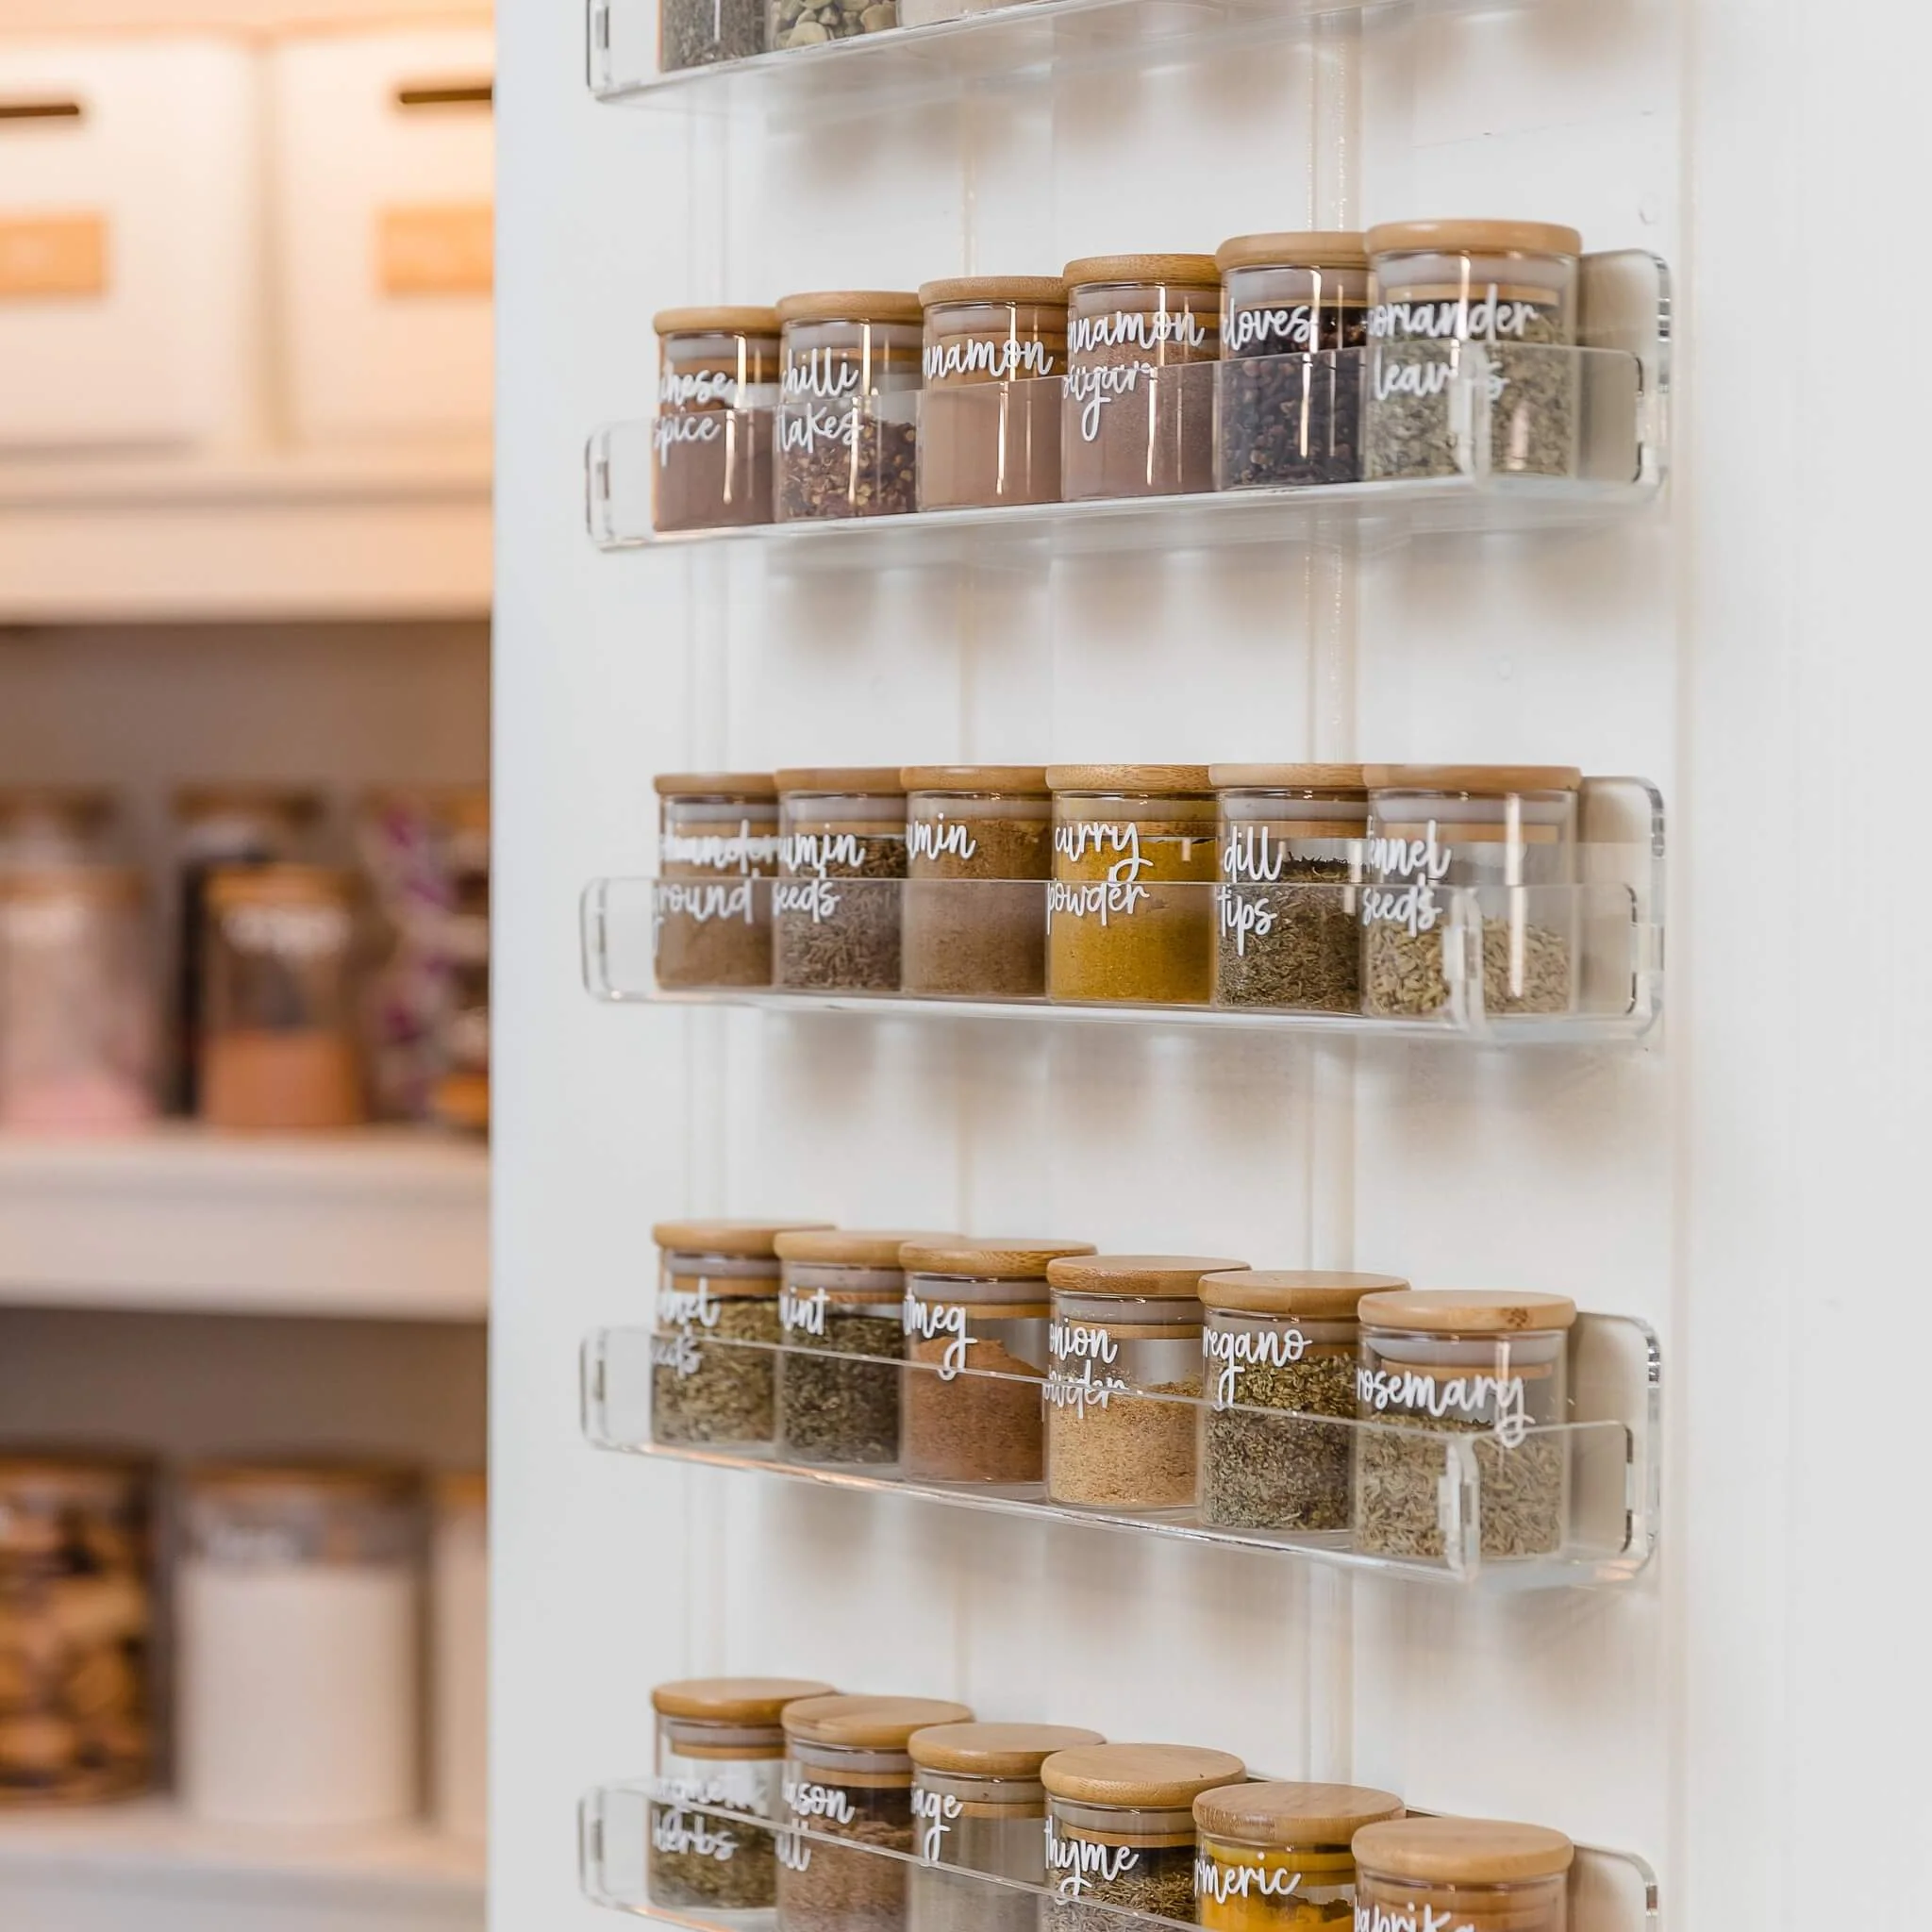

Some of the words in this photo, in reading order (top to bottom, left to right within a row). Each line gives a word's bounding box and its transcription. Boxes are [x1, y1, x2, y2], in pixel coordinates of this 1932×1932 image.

[924, 339, 1054, 379] nnamon
[1068, 310, 1205, 354] nnamon
[1374, 346, 1510, 401] leavs
[1055, 822, 1153, 885] curry
[1224, 825, 1284, 883] dill
[653, 869, 758, 925] round
[1218, 885, 1277, 956] tips
[778, 1286, 831, 1335] int
[1202, 1325, 1312, 1412] regano
[910, 1782, 963, 1866] age
[1043, 1815, 1140, 1906] thyme
[1193, 1852, 1301, 1904] rmeric
